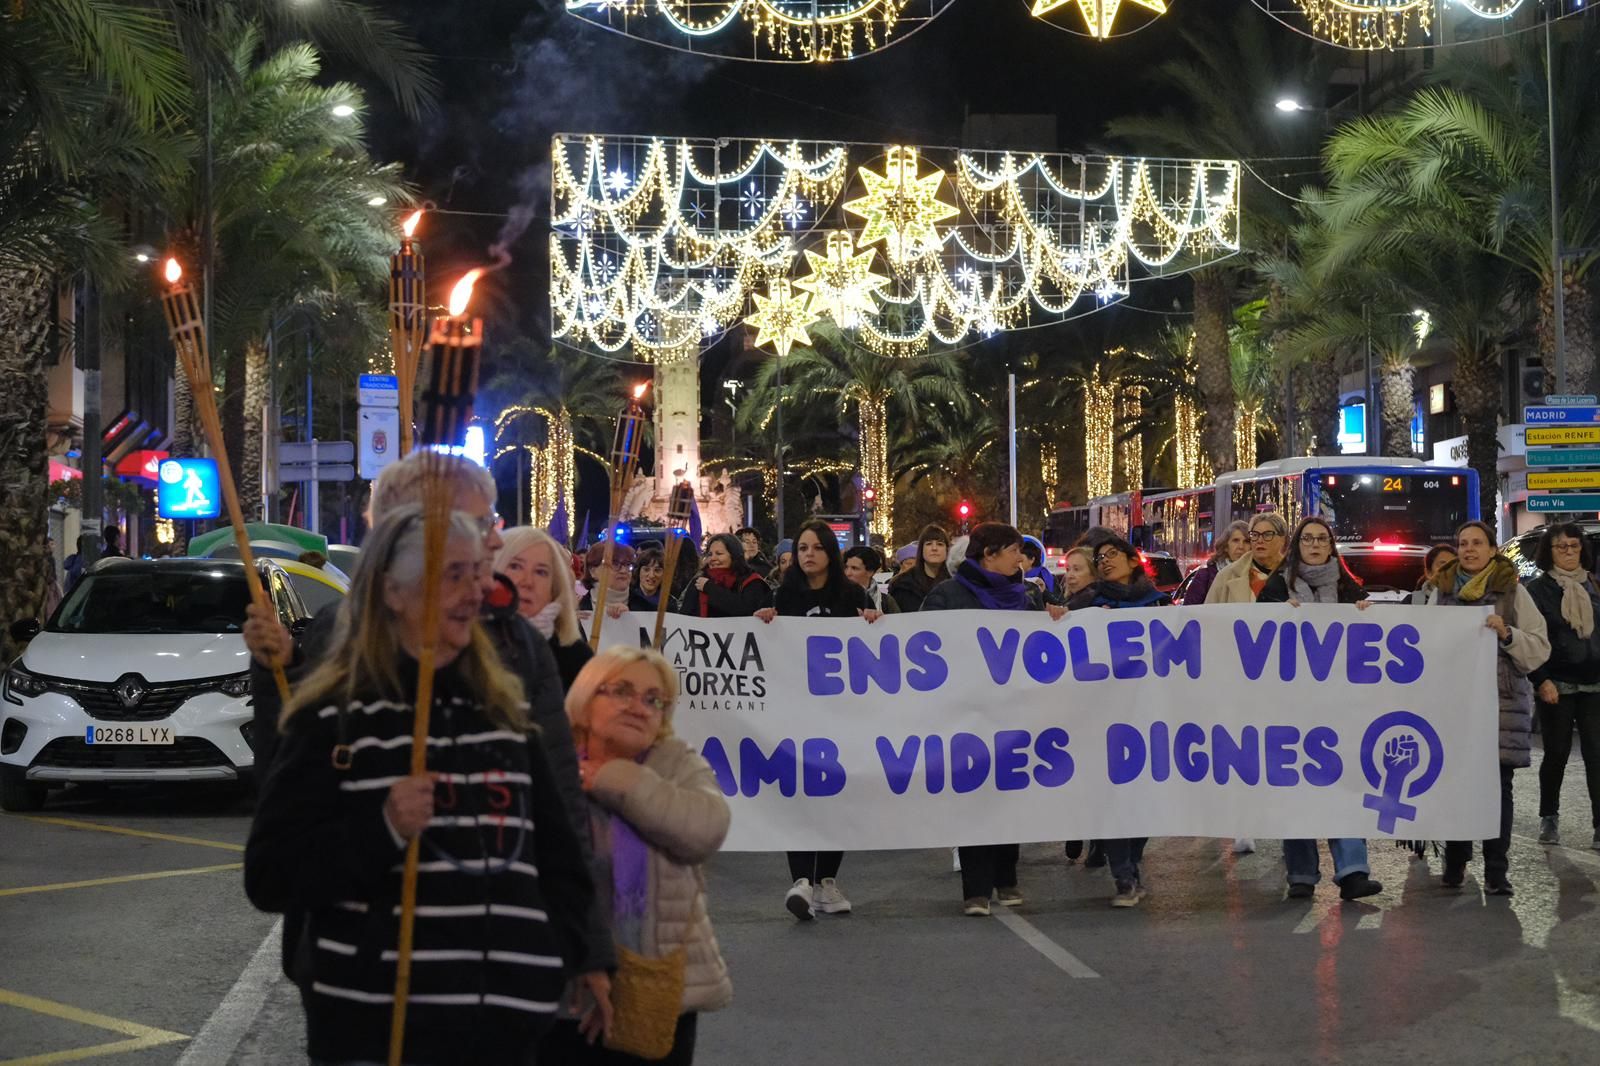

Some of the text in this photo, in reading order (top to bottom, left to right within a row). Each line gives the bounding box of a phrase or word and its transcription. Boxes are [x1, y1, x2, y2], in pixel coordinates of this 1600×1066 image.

[1526, 411, 1566, 420] MADRID
[1564, 431, 1595, 439] RENFE
[1383, 478, 1402, 491] 24
[1529, 499, 1549, 507] Gran
[807, 620, 1424, 695] ENS VOLEM VIVES
[689, 700, 765, 711] ALACANT
[95, 727, 169, 742] 0268 LYX
[702, 722, 1343, 797] AMB VIDES DIGNES
